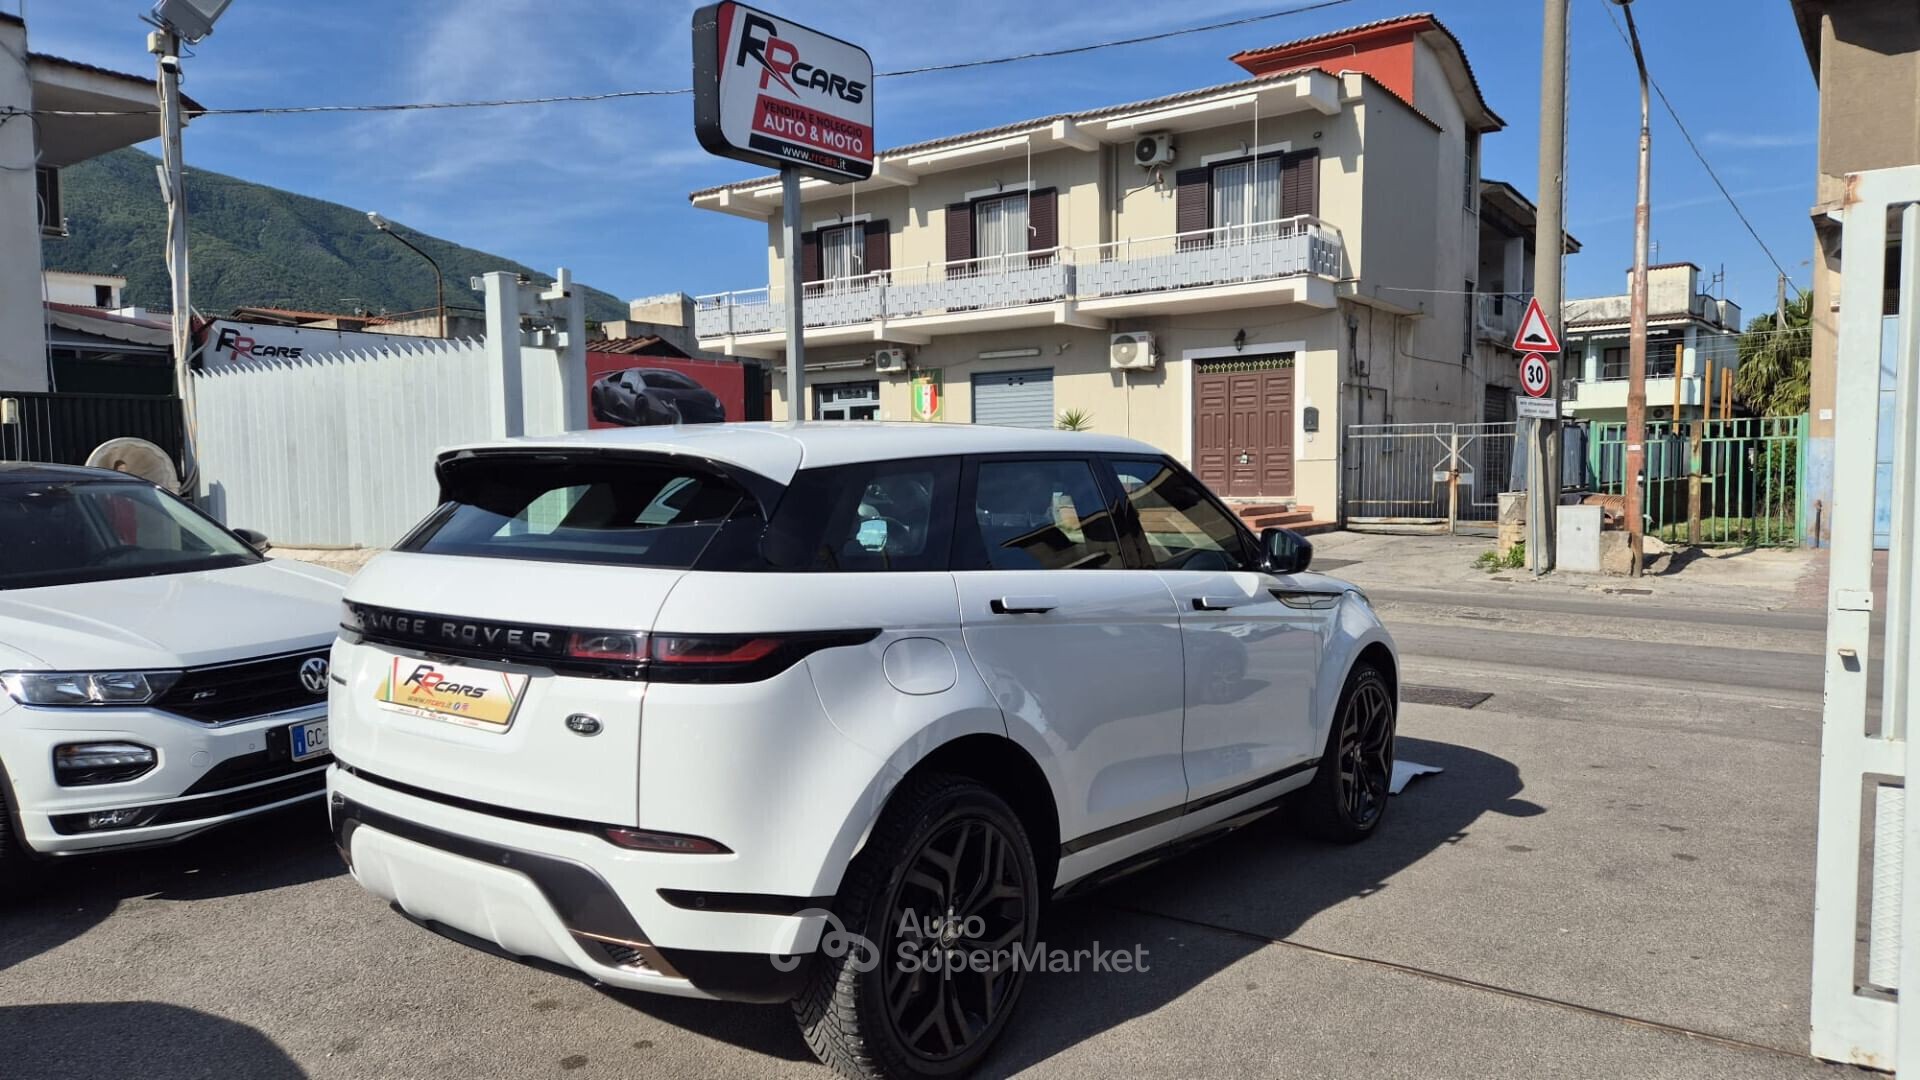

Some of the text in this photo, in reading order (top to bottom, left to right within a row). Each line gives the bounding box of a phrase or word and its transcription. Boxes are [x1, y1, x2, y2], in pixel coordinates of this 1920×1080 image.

[763, 100, 863, 138] VENDITA E NOLEGGIO
[763, 113, 863, 153] AUTO & MOTO
[782, 146, 846, 170] www.rrcars.it
[1527, 365, 1544, 384] 30
[355, 610, 551, 648] RANGE ROVER
